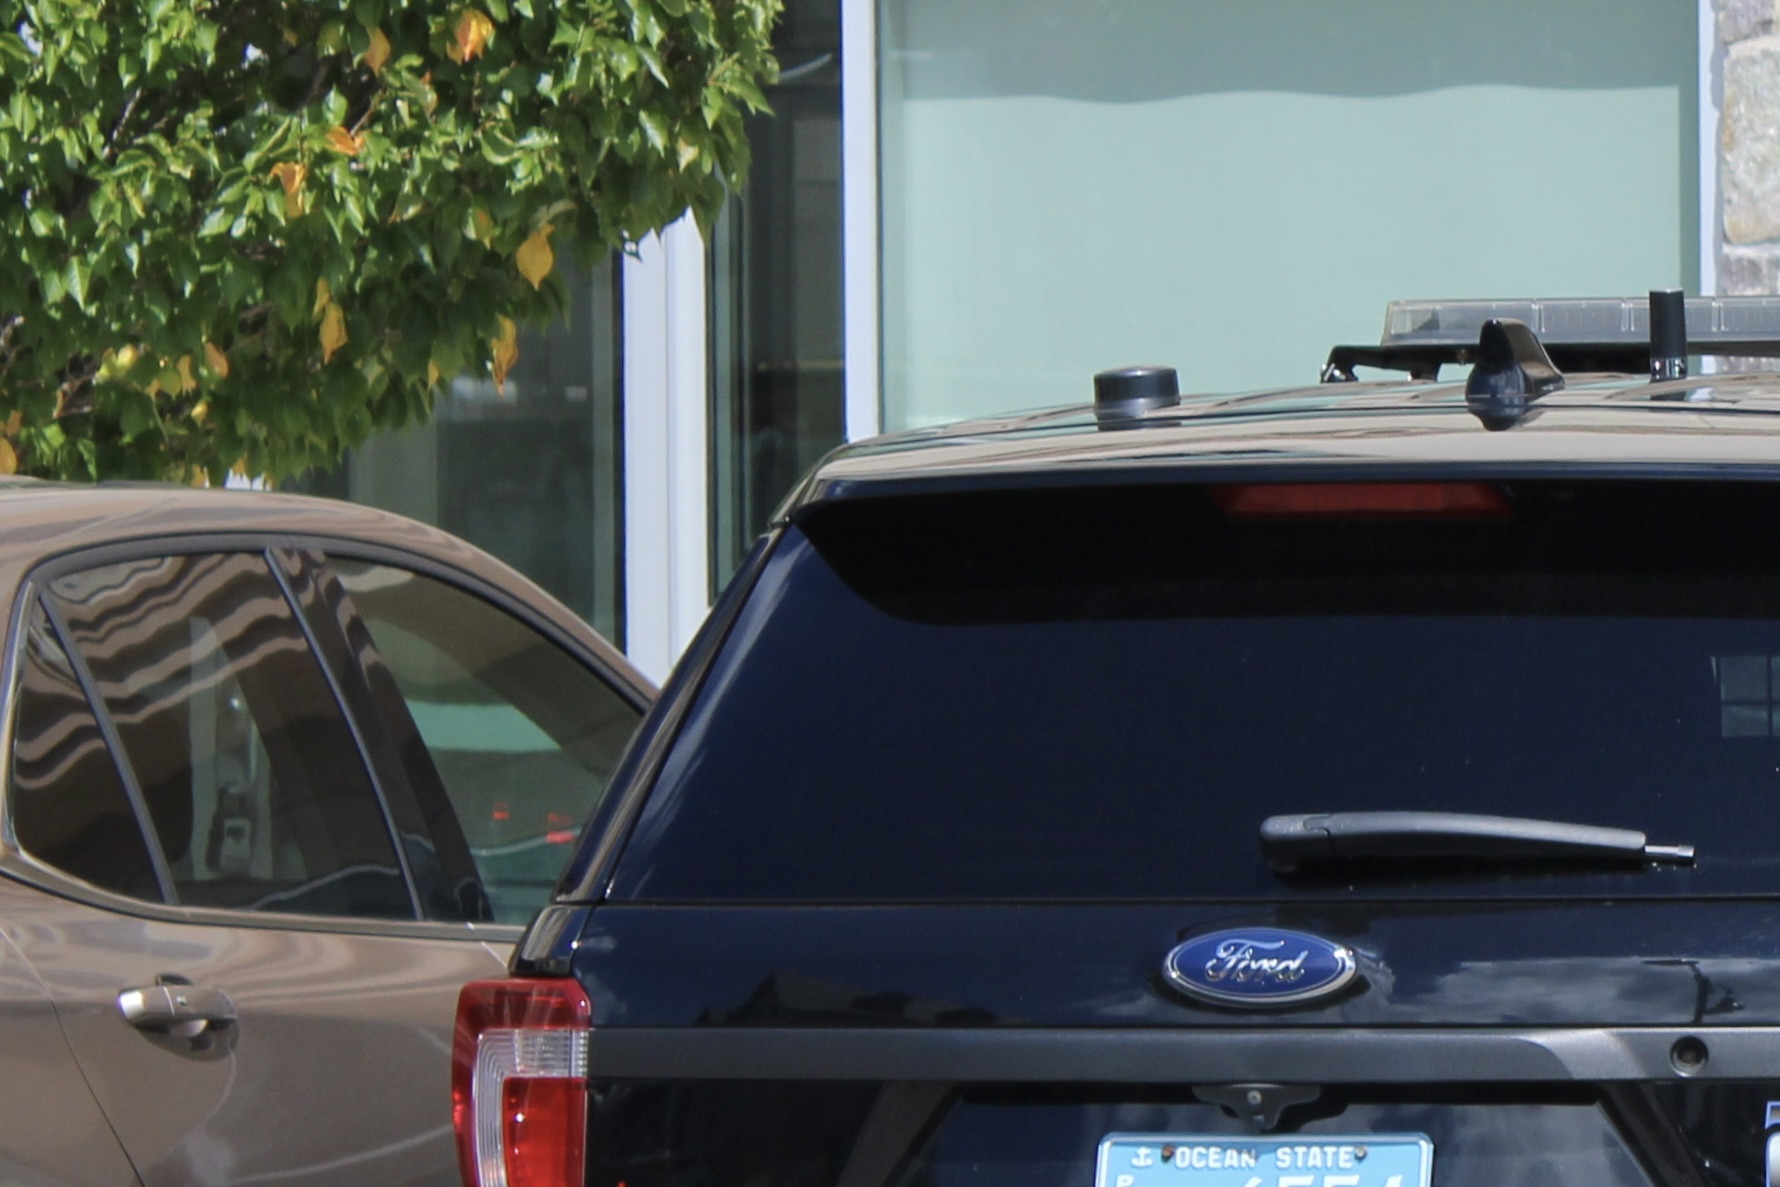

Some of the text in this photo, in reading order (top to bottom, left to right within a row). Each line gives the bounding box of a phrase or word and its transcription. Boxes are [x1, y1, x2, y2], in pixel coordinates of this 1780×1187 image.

[1205, 938, 1309, 982] Ford
[1174, 1146, 1355, 1169] OCEAN STATE
